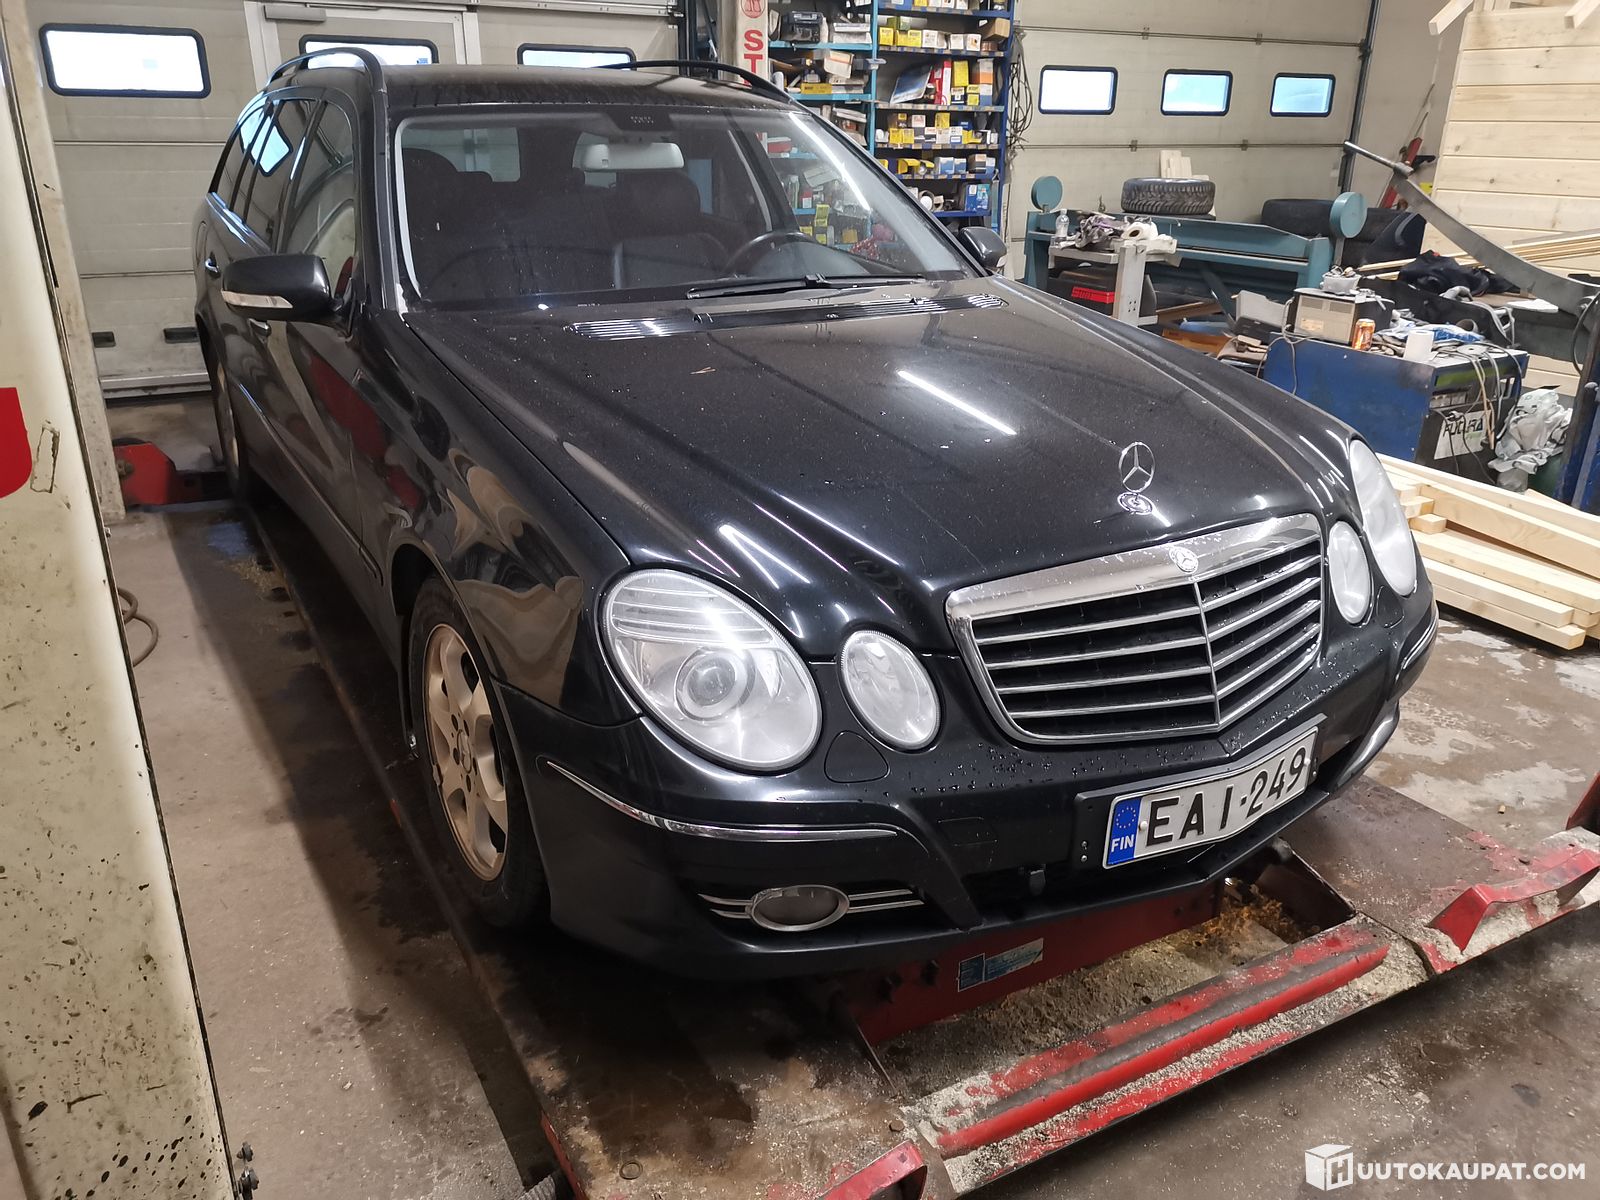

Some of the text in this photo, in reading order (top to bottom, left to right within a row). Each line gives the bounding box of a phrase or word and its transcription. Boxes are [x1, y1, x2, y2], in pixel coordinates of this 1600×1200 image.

[743, 29, 764, 86] ST
[1146, 746, 1307, 847] EAI-249
[1111, 834, 1135, 853] FIN
